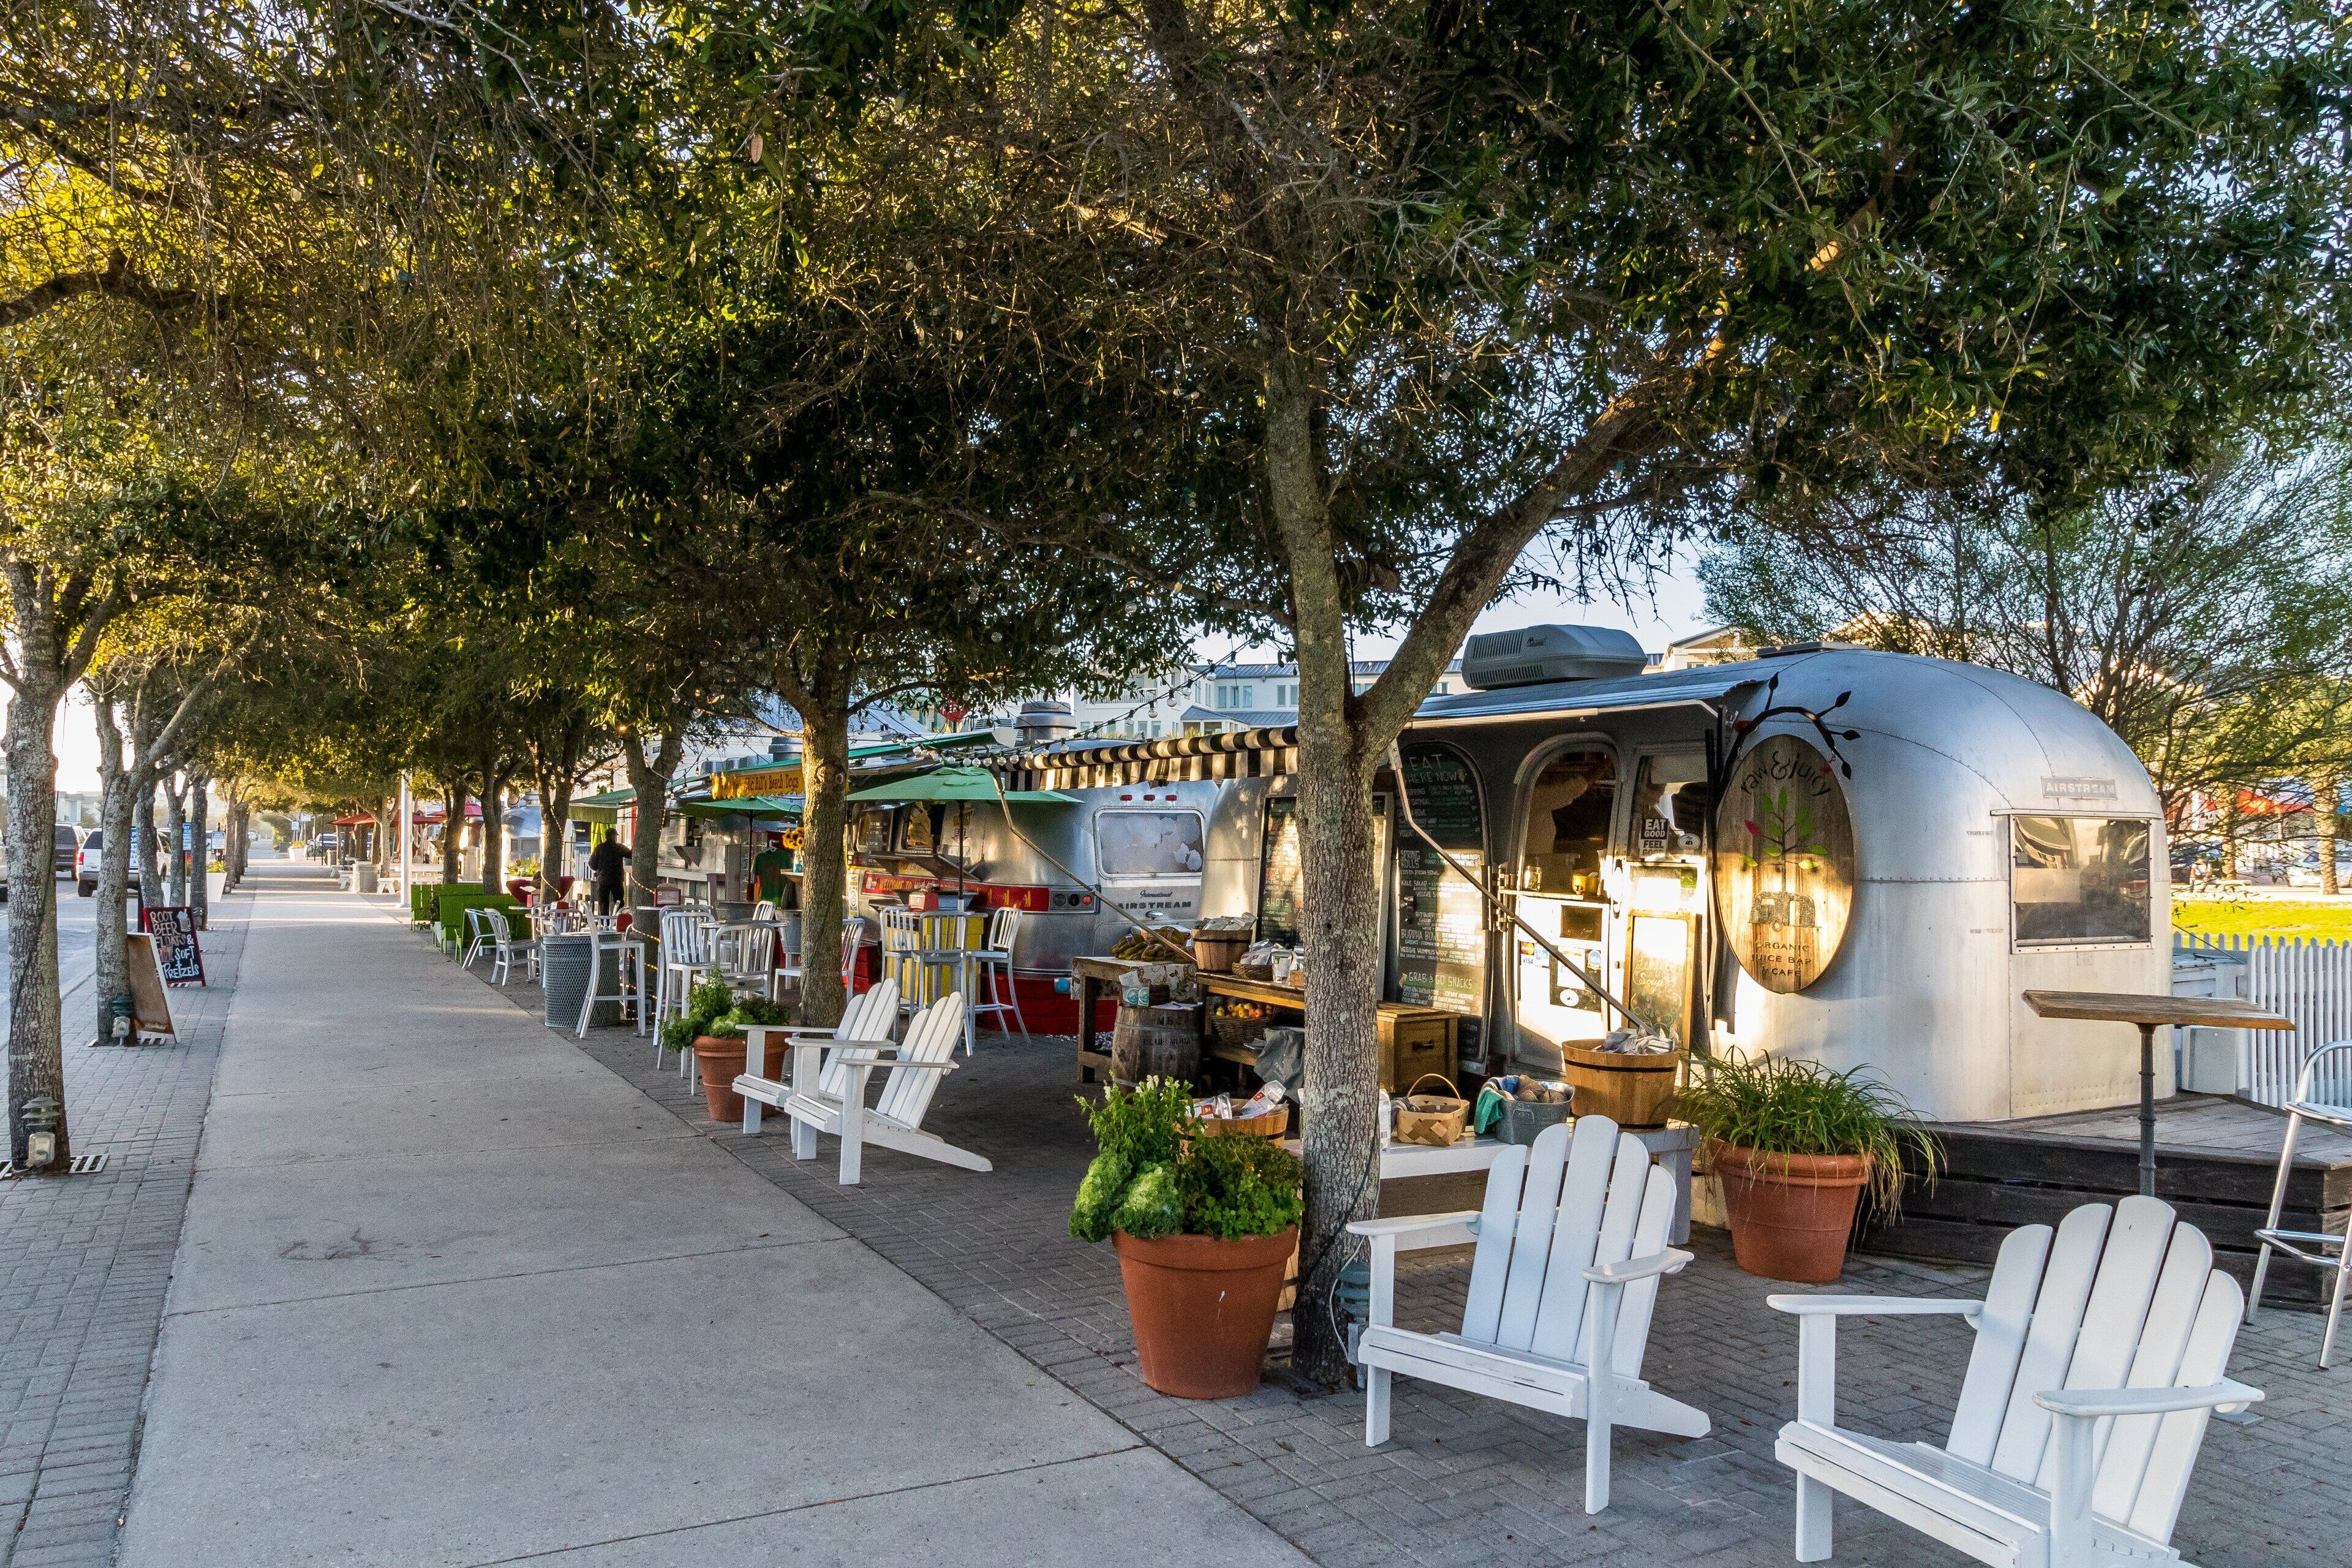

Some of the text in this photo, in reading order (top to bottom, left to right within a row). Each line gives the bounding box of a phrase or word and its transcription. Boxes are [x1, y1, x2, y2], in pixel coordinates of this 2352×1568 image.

[1409, 753, 1442, 771] EAT
[1408, 771, 1457, 783] HERE NOW
[1741, 766, 1768, 794] raw
[1789, 753, 1832, 796] juicy
[2046, 782, 2115, 793] AIRSTREAM
[1645, 819, 1666, 830] EAT
[1643, 840, 1665, 849] FEEL
[1400, 850, 1420, 859] SPRING
[1401, 859, 1420, 869] ROLLS
[880, 878, 904, 891] WELCOME
[1140, 889, 1173, 899] International
[1118, 901, 1191, 910] AIRSTREAM
[1266, 897, 1289, 908] SHOTS
[149, 911, 173, 924] ROOT
[153, 921, 182, 937] BEER
[1401, 929, 1442, 941] BUDDHA BOWL
[156, 933, 195, 949] FLOATS &
[1757, 941, 1809, 952] ORGANIC
[175, 945, 195, 960] SOFT
[1417, 947, 1435, 956] HUMMUS
[1752, 954, 1812, 965] JUICE BAR
[1409, 971, 1427, 983] GRAB
[1435, 974, 1445, 985] GO
[1447, 976, 1472, 989] SNACKS
